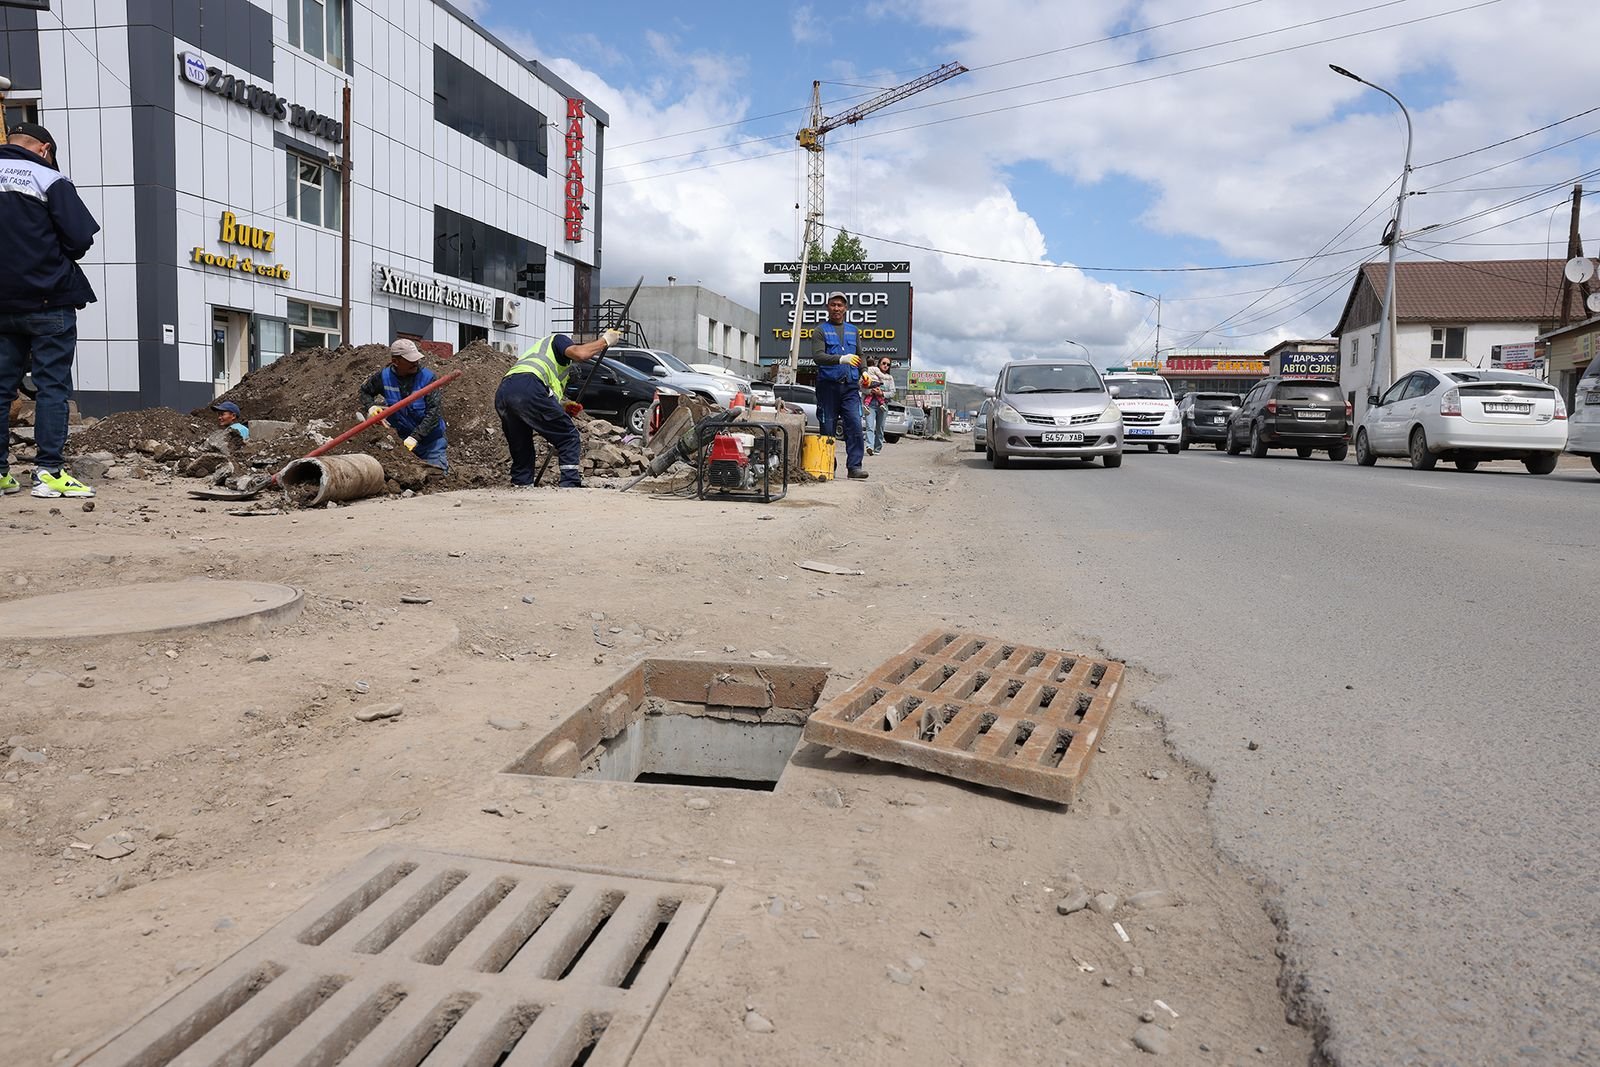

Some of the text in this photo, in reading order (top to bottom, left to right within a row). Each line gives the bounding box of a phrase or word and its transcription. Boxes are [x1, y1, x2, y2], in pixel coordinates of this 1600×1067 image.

[188, 67, 205, 82] MD
[206, 66, 287, 121] ZALUUS
[222, 211, 275, 252] Buuz
[193, 247, 291, 281] Food & cafe
[823, 263, 884, 272] РАДИАТОР
[780, 292, 889, 306] RADITOR
[788, 310, 878, 323] SERICE
[1282, 364, 1307, 373] АВТО
[1045, 433, 1055, 442] 54
[1056, 433, 1065, 442] 57
